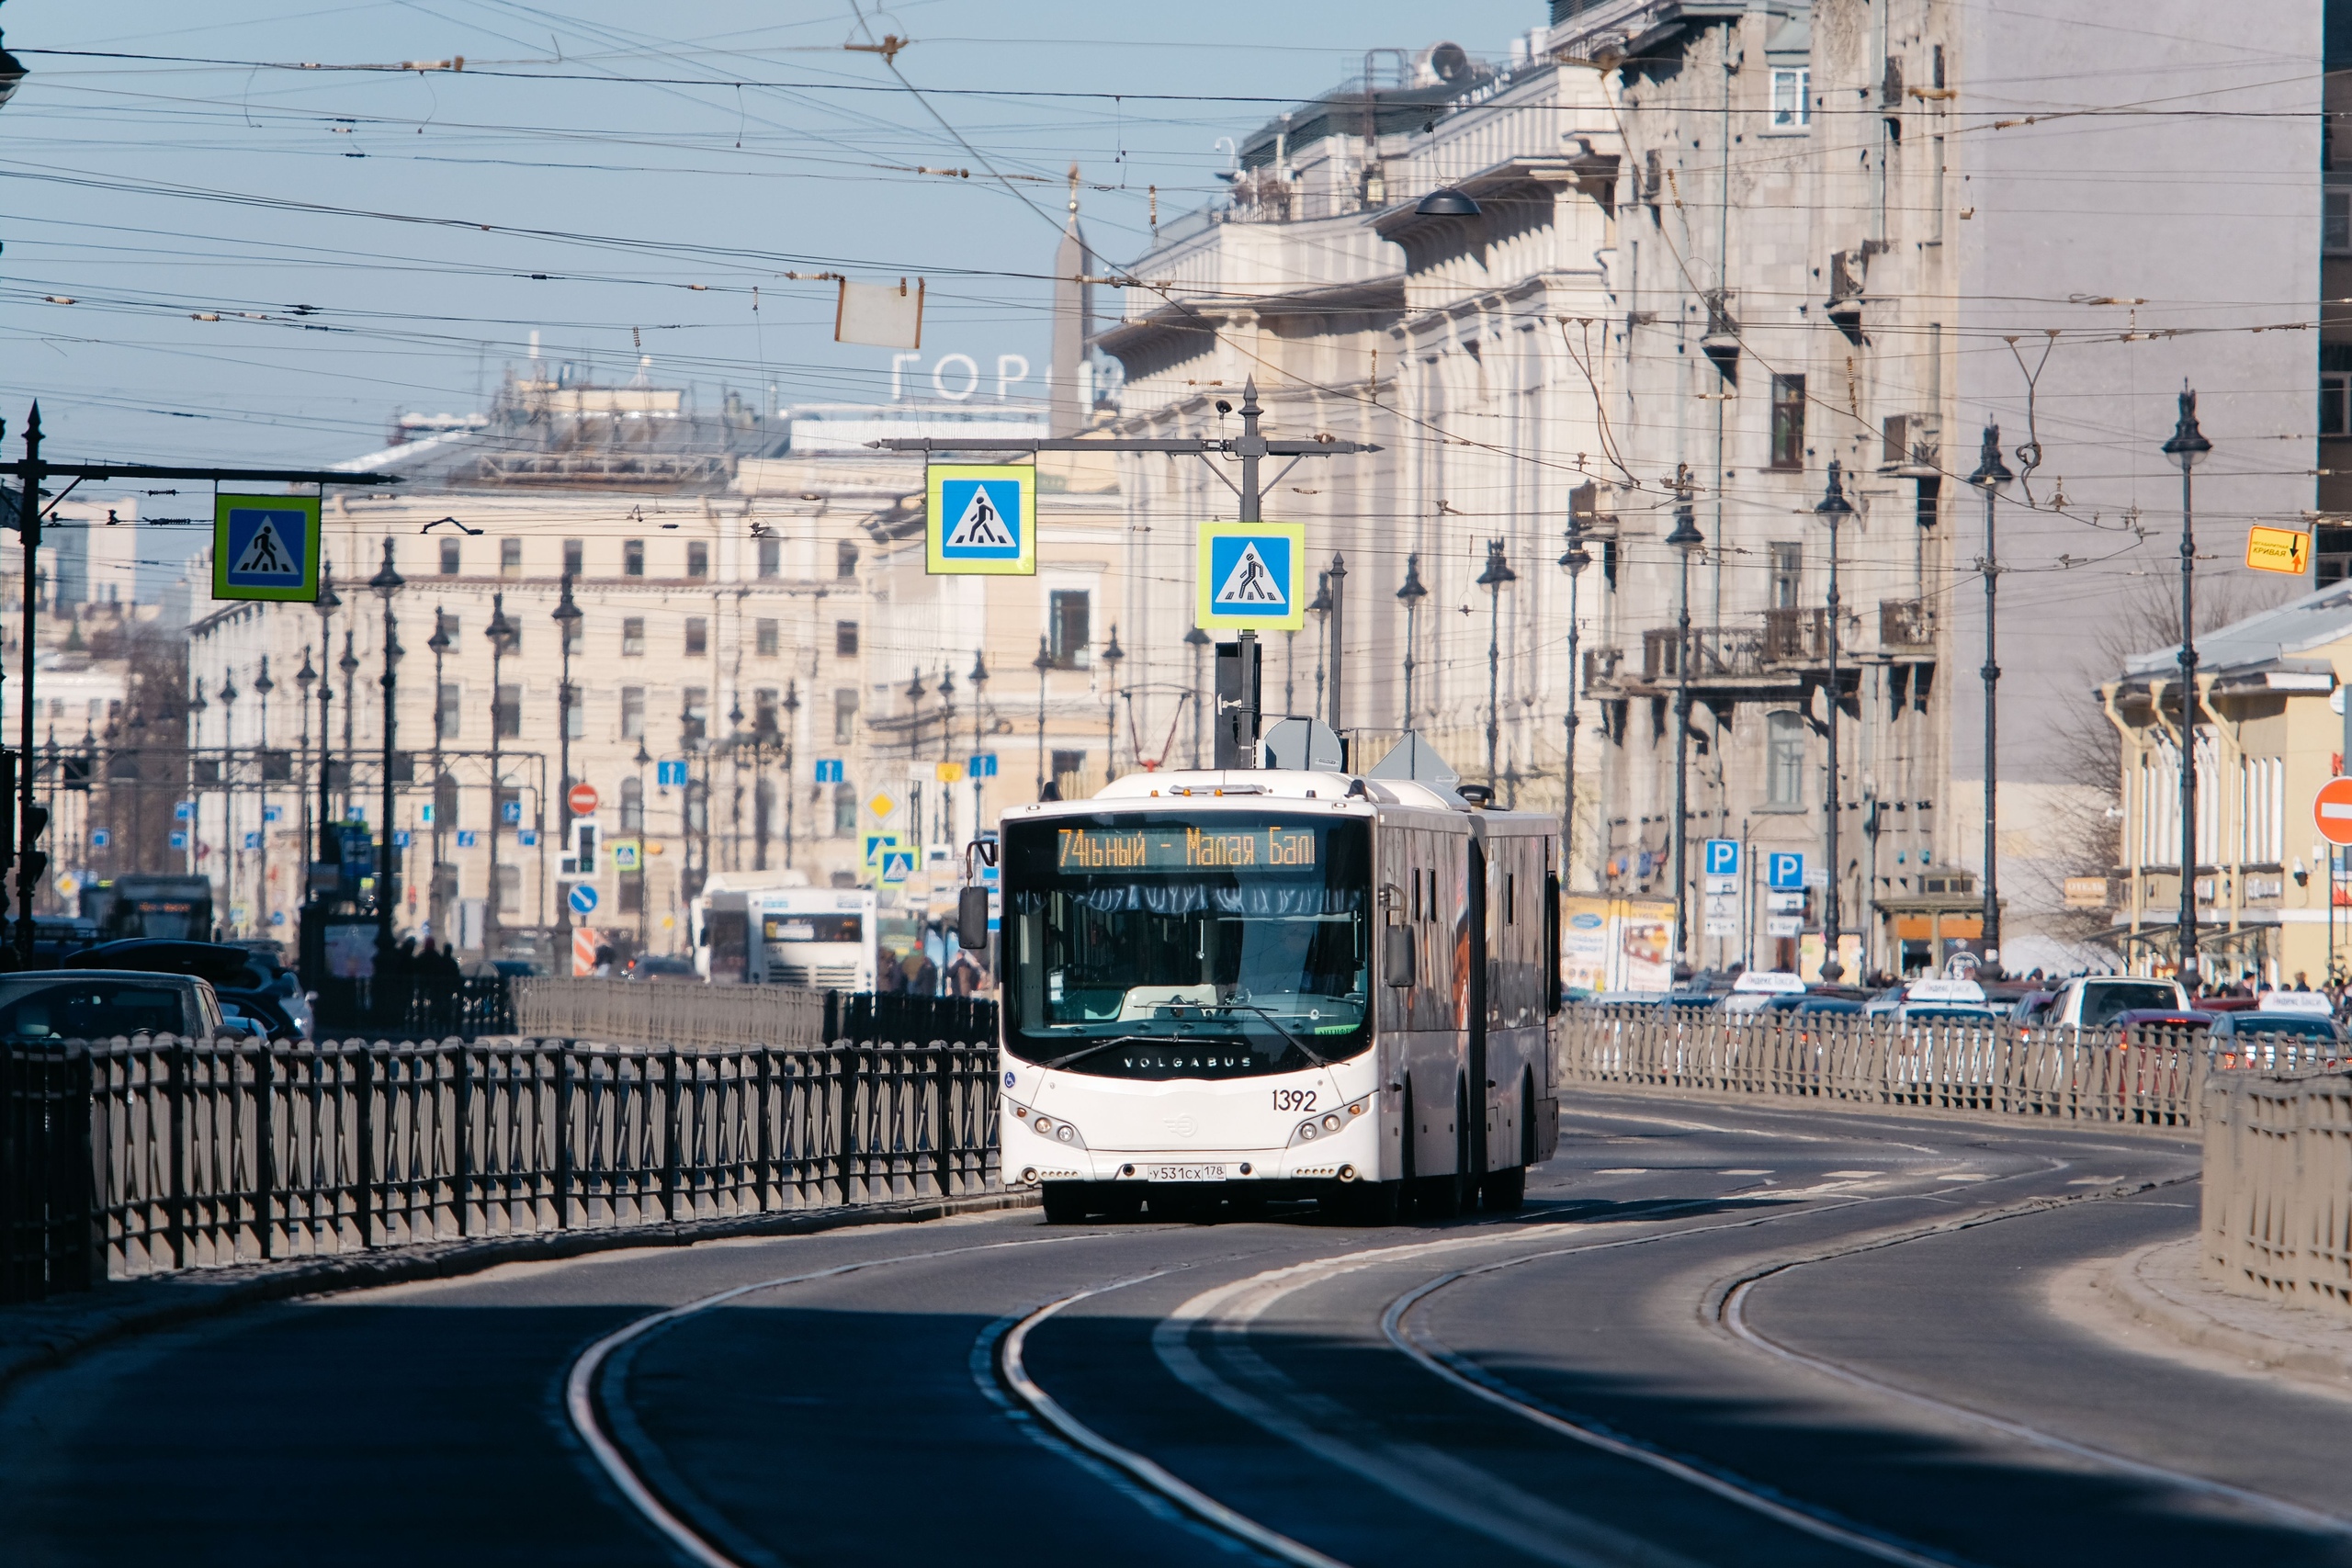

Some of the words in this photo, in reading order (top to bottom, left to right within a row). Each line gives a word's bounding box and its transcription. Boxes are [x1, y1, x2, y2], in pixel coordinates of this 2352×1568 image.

[890, 352, 1053, 401] ГОР
[2252, 547, 2287, 557] КРИВАЯ
[1186, 828, 1254, 866] Малая
[1269, 826, 1315, 864] Бал
[1124, 1057, 1250, 1067] VOLGABUS
[1272, 1089, 1317, 1112] 1392
